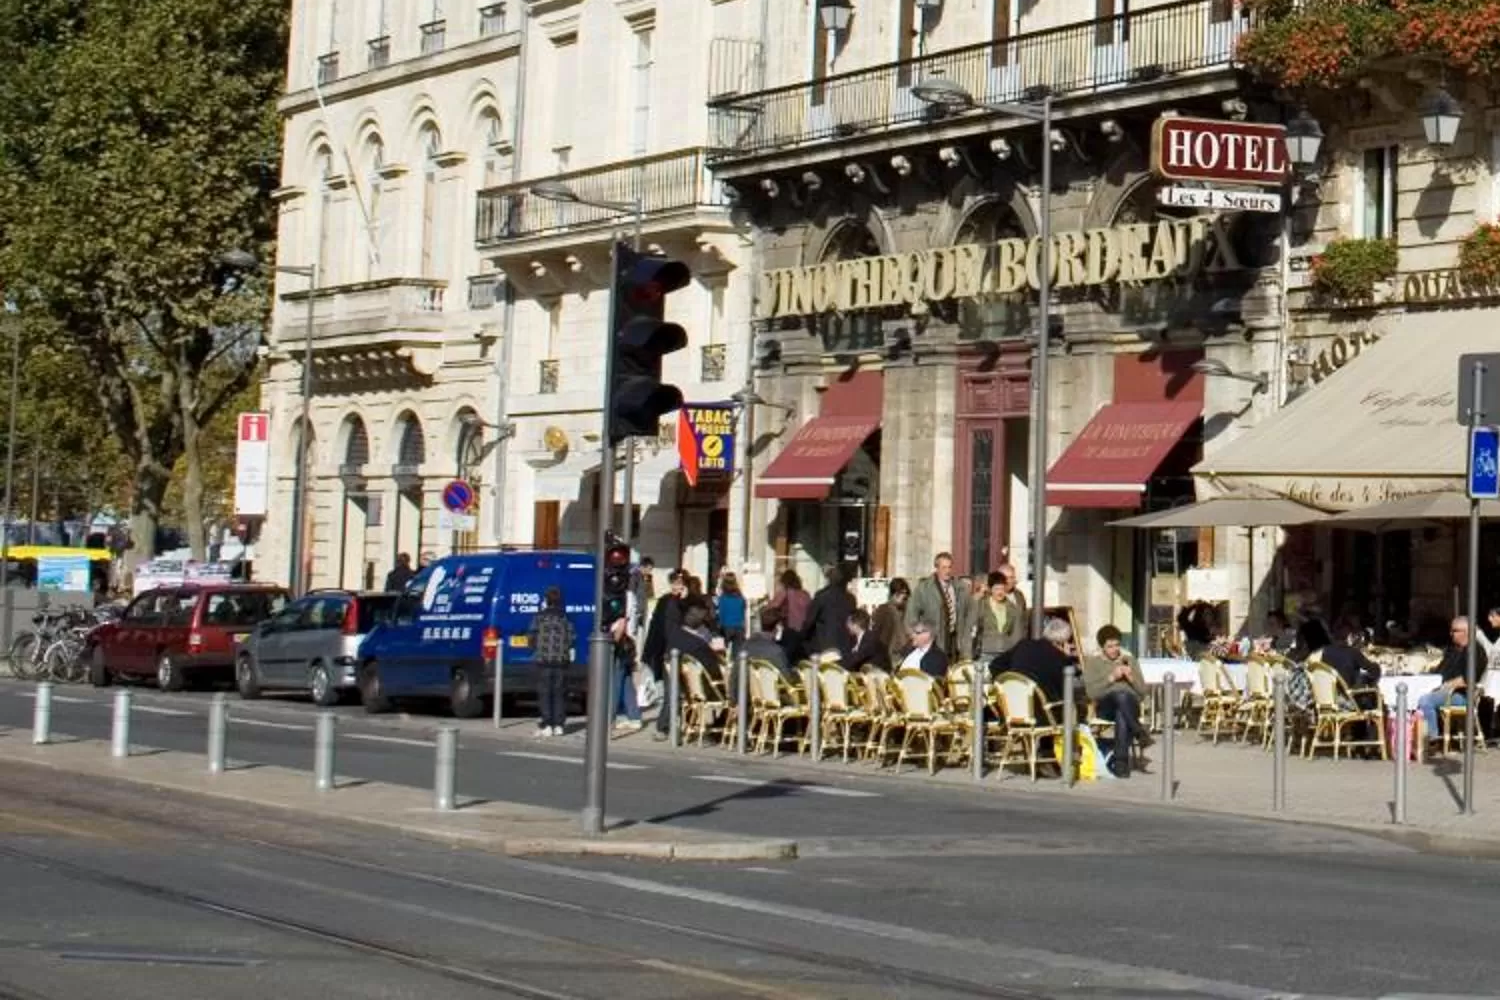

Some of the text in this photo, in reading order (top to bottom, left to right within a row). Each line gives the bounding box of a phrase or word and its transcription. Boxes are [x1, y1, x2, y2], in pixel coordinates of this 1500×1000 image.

[1167, 129, 1286, 173] HOTEL
[1162, 186, 1196, 206] Les
[1203, 191, 1214, 207] 4
[994, 212, 1245, 293] BORDEAUX
[687, 409, 731, 424] TABAC
[698, 456, 725, 469] LOTO
[510, 593, 541, 605] FROID
